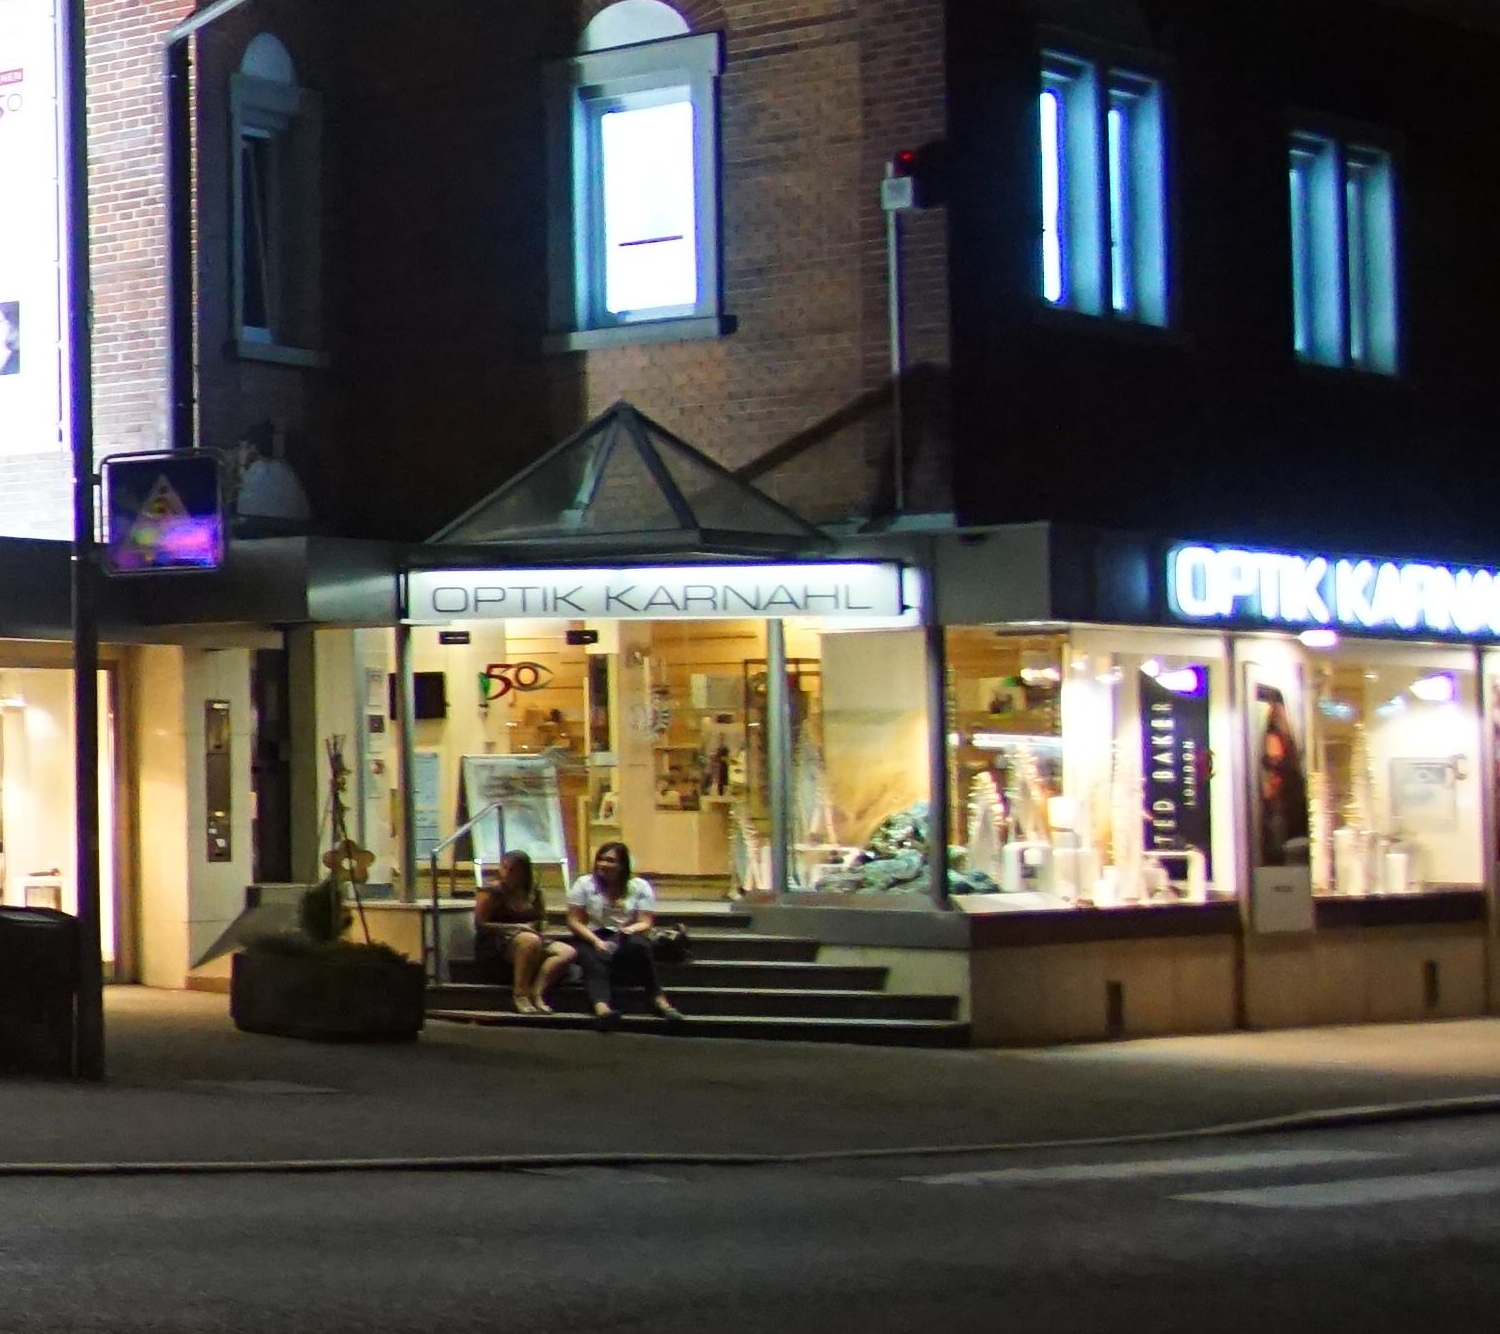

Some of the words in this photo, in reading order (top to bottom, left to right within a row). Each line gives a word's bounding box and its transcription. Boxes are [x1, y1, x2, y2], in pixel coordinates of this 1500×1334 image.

[432, 585, 589, 613] OPTIK
[605, 584, 873, 612] KARNAHL
[1168, 546, 1330, 623] OPTIK
[1336, 559, 1500, 634] KARNA
[1150, 703, 1175, 779] BAKER
[1182, 740, 1196, 806] LONDON
[1152, 800, 1176, 844] TED
